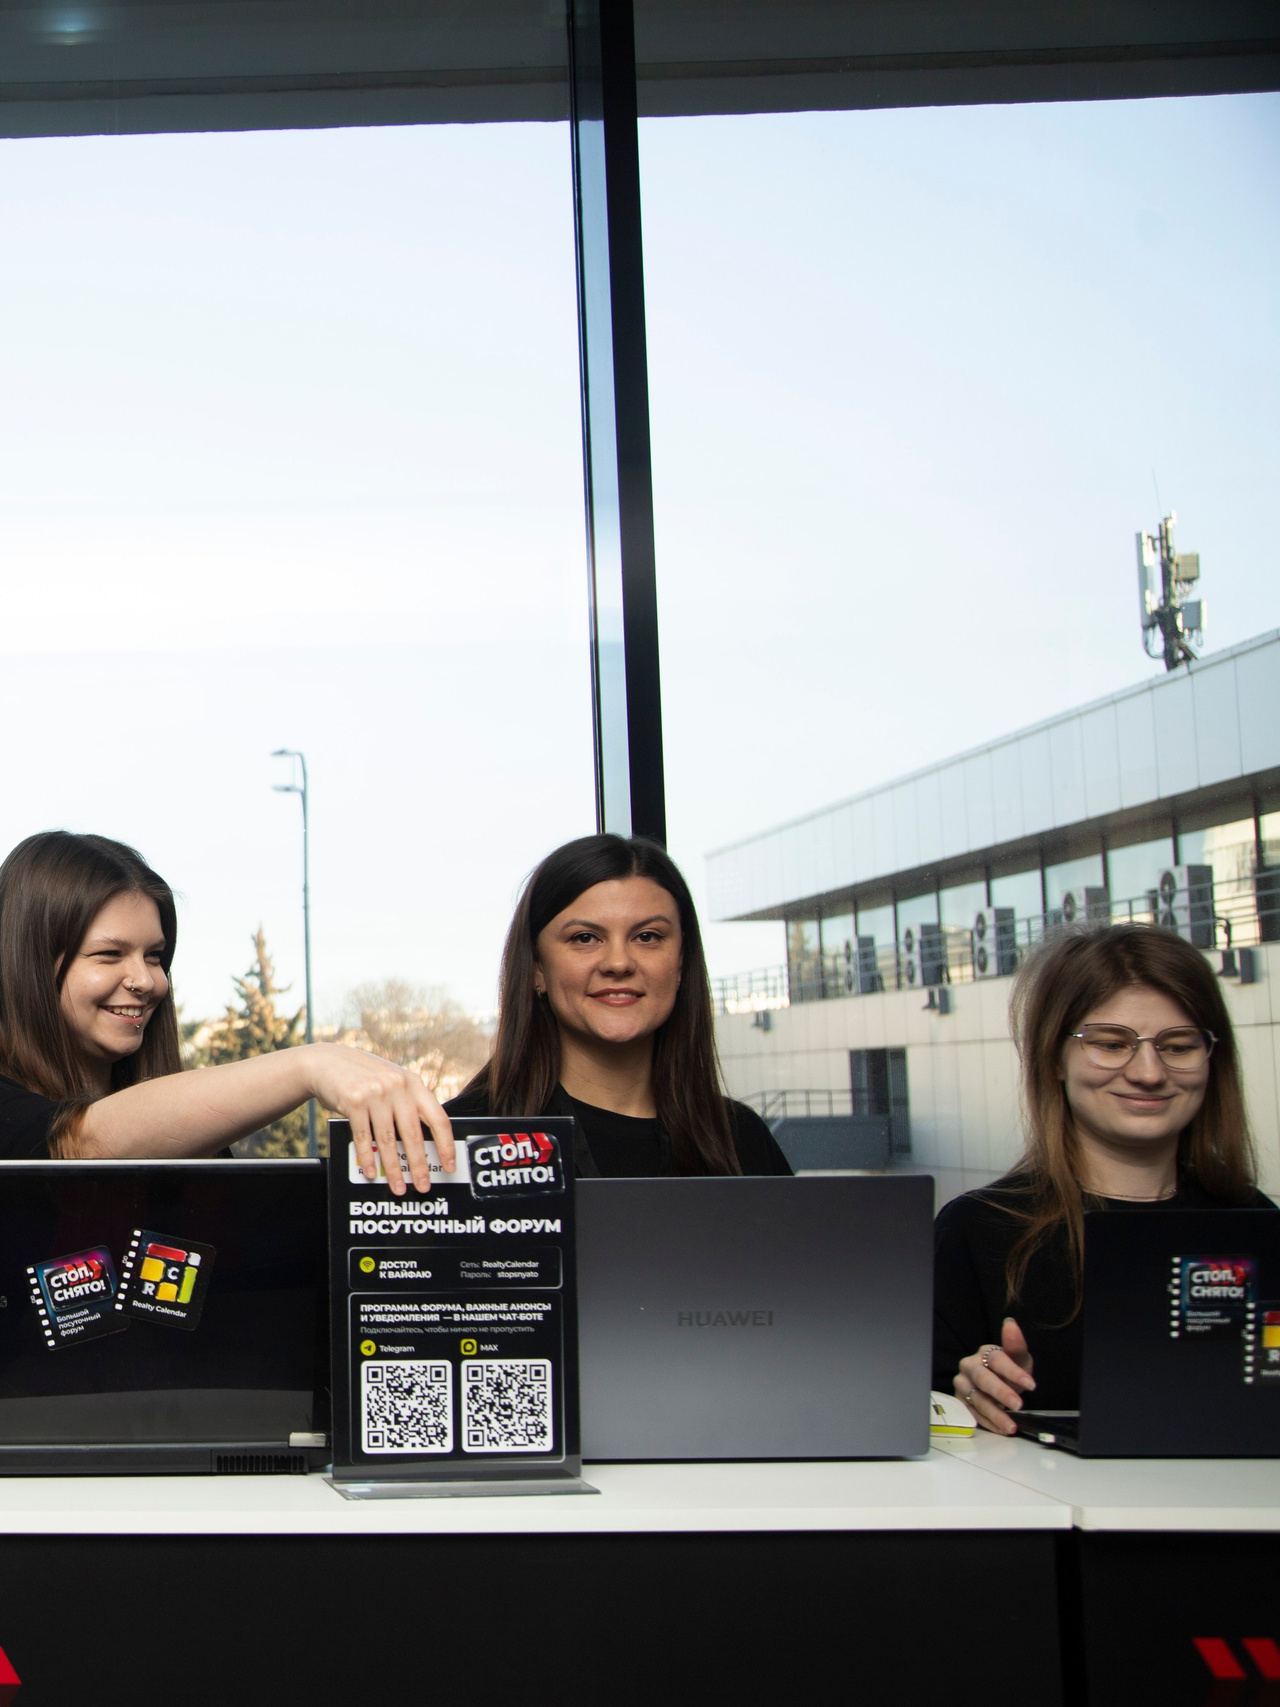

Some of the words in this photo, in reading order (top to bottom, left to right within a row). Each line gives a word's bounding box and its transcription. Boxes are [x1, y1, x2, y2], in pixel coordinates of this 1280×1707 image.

[474, 1141, 539, 1166] СТОП,
[475, 1166, 555, 1187] СНЯТО!
[349, 1198, 448, 1216] БОЛЬШОЙ
[350, 1216, 485, 1234] ПОСУТОЧНЫЙ
[490, 1218, 561, 1234] ФОРУМ
[379, 1260, 417, 1270] ДОСТУП
[482, 1260, 539, 1270] RealtyCalendar
[50, 1266, 94, 1288] СТОП,
[379, 1271, 386, 1279] К
[388, 1269, 432, 1279] ВАЙФАЮ
[497, 1270, 539, 1280] stopsnyato
[1191, 1270, 1236, 1283] СТОП,
[54, 1280, 106, 1301] СНЯТО!
[1191, 1286, 1244, 1298] СНЯТО!
[132, 1300, 155, 1312] Realty
[155, 1306, 187, 1318] Calendar
[360, 1304, 420, 1312] ПРОГРАММА
[420, 1303, 465, 1313] ФОРУМА,
[466, 1303, 508, 1311] ВАЖНЫЕ
[509, 1303, 552, 1311] АНОНСЫ
[360, 1314, 368, 1322] И
[369, 1313, 440, 1323] УВЕДОМЛЕНИЯ
[453, 1313, 460, 1321] В
[462, 1313, 498, 1321] НАШЕМ
[499, 1313, 544, 1321] ЧАТ-БОТЕ
[678, 1310, 773, 1327] HUAWEI
[379, 1345, 415, 1354] Telegram
